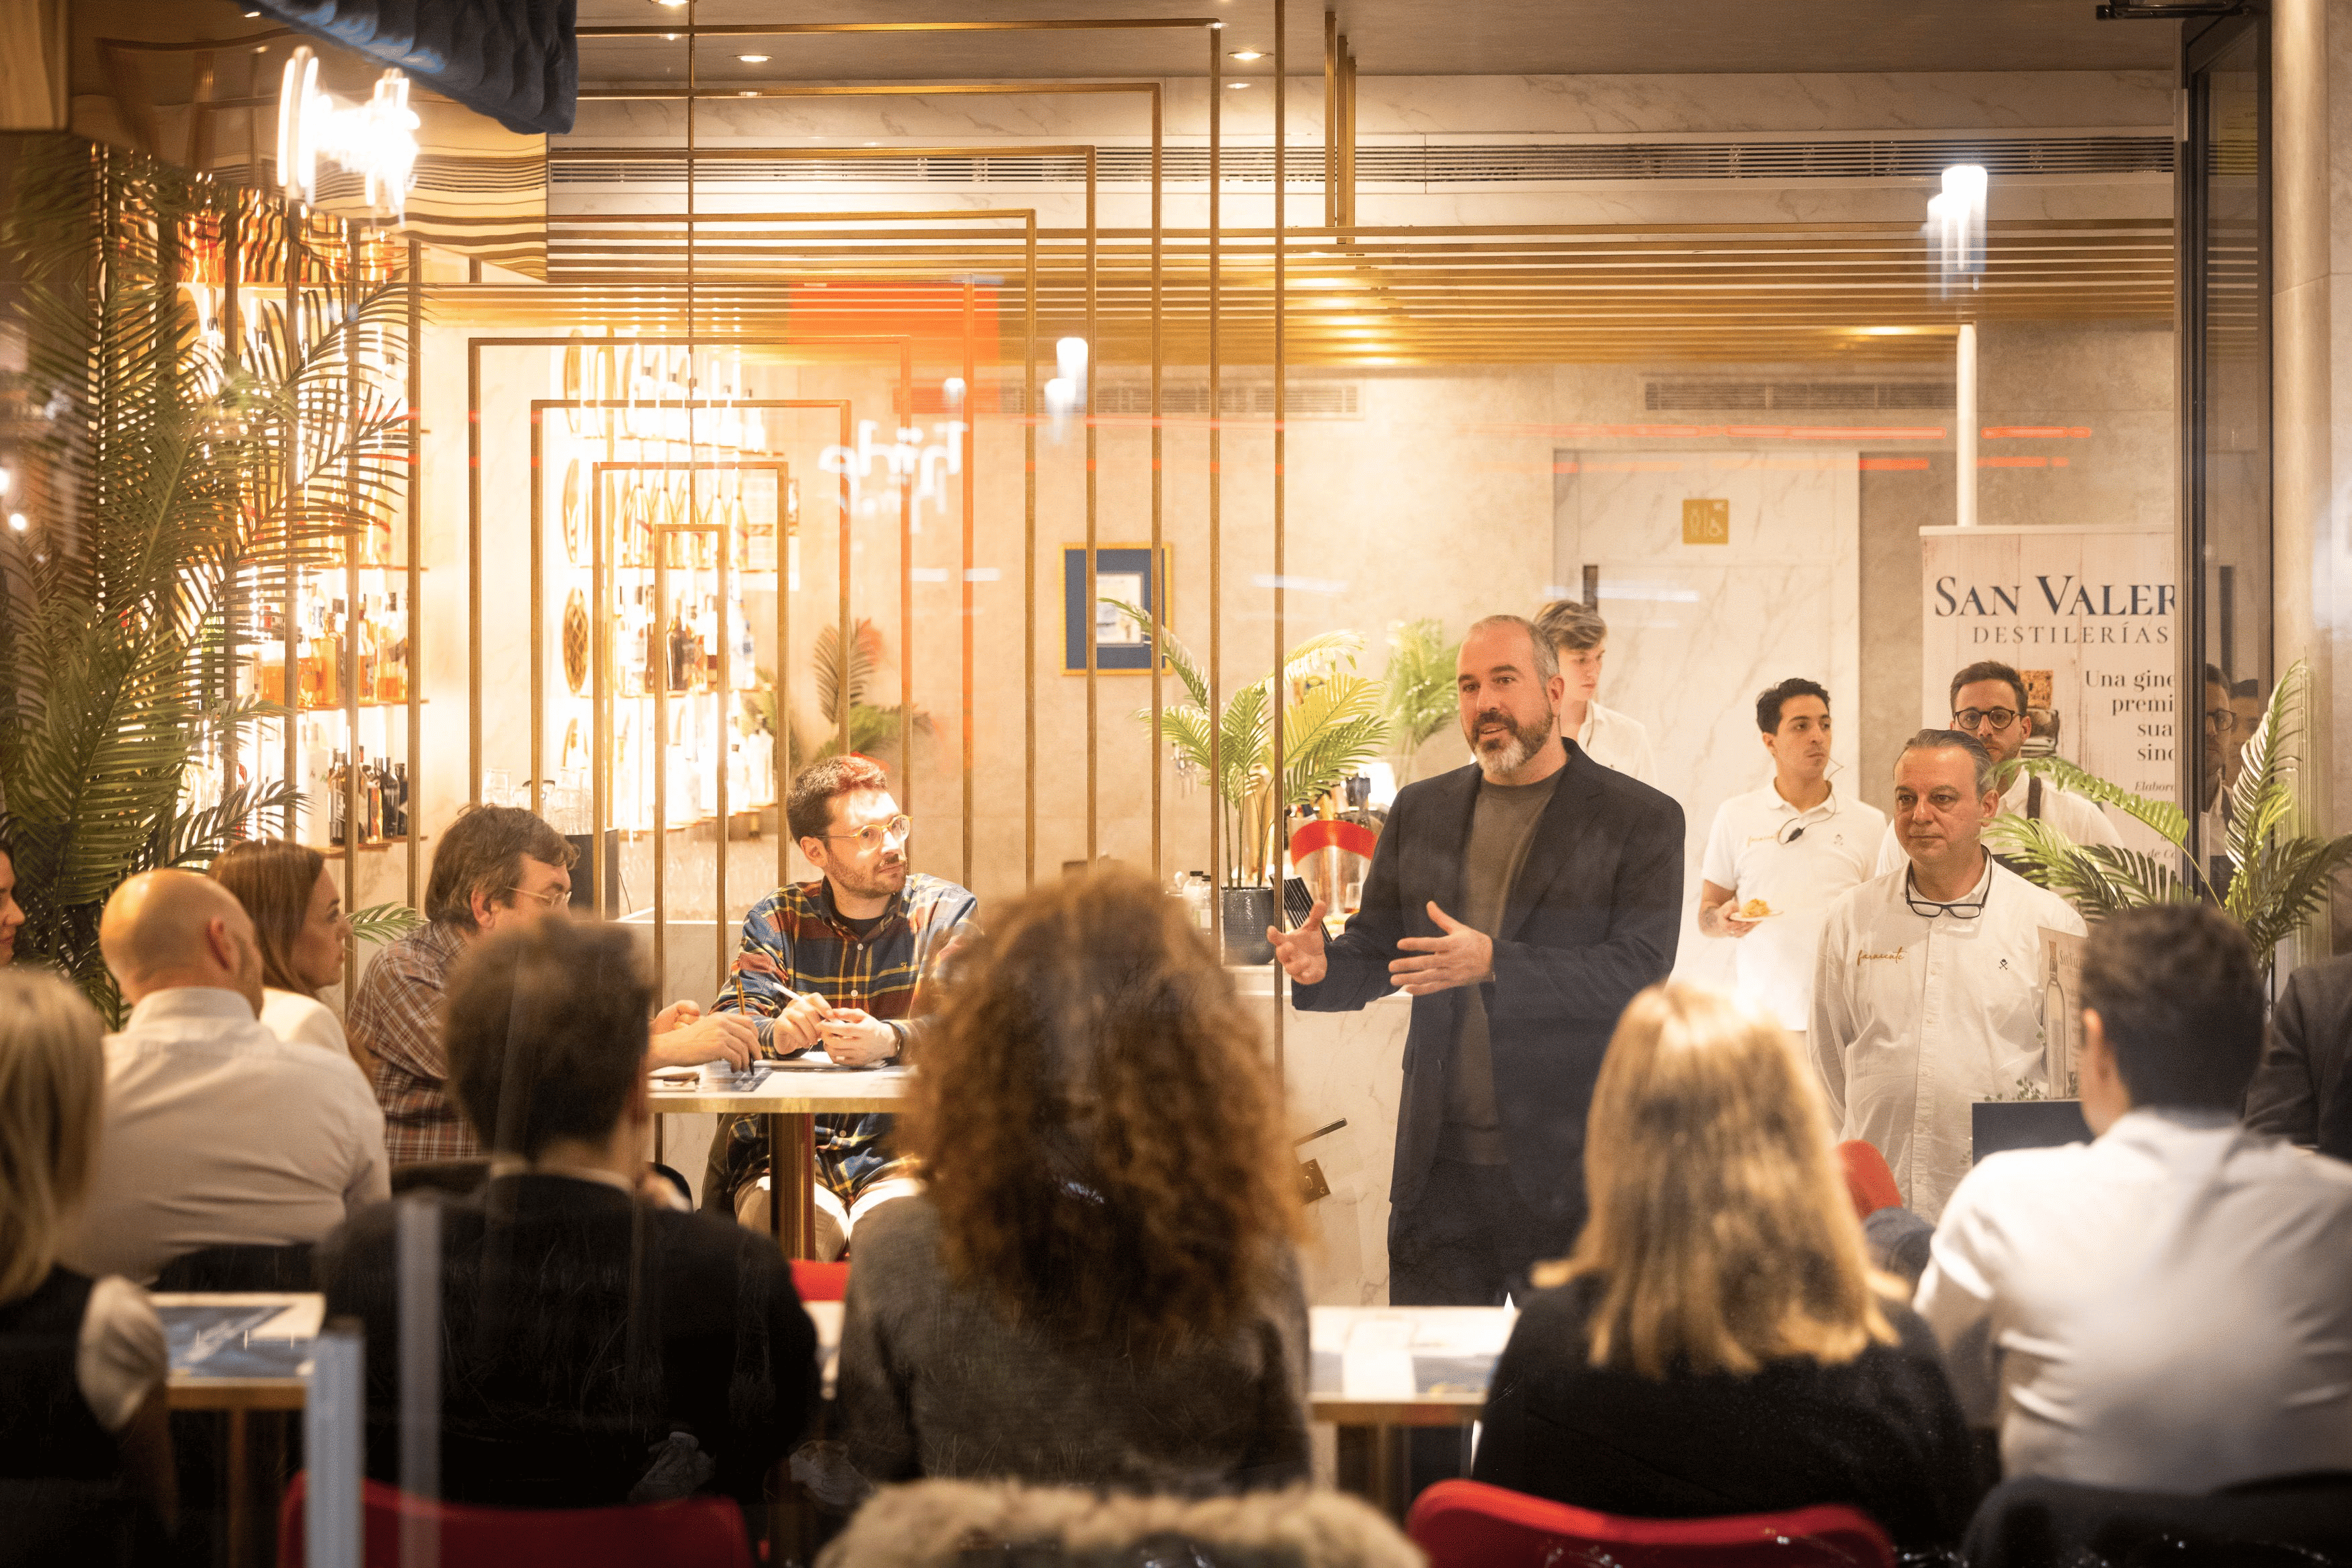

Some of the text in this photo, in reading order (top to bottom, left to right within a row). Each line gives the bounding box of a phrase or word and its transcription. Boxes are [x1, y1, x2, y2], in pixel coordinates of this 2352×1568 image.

[1935, 575, 2175, 617] SAN VALER
[1973, 622, 2169, 644] DESTILERÍAS
[2085, 670, 2126, 688] Una
[2137, 724, 2175, 737] sua
